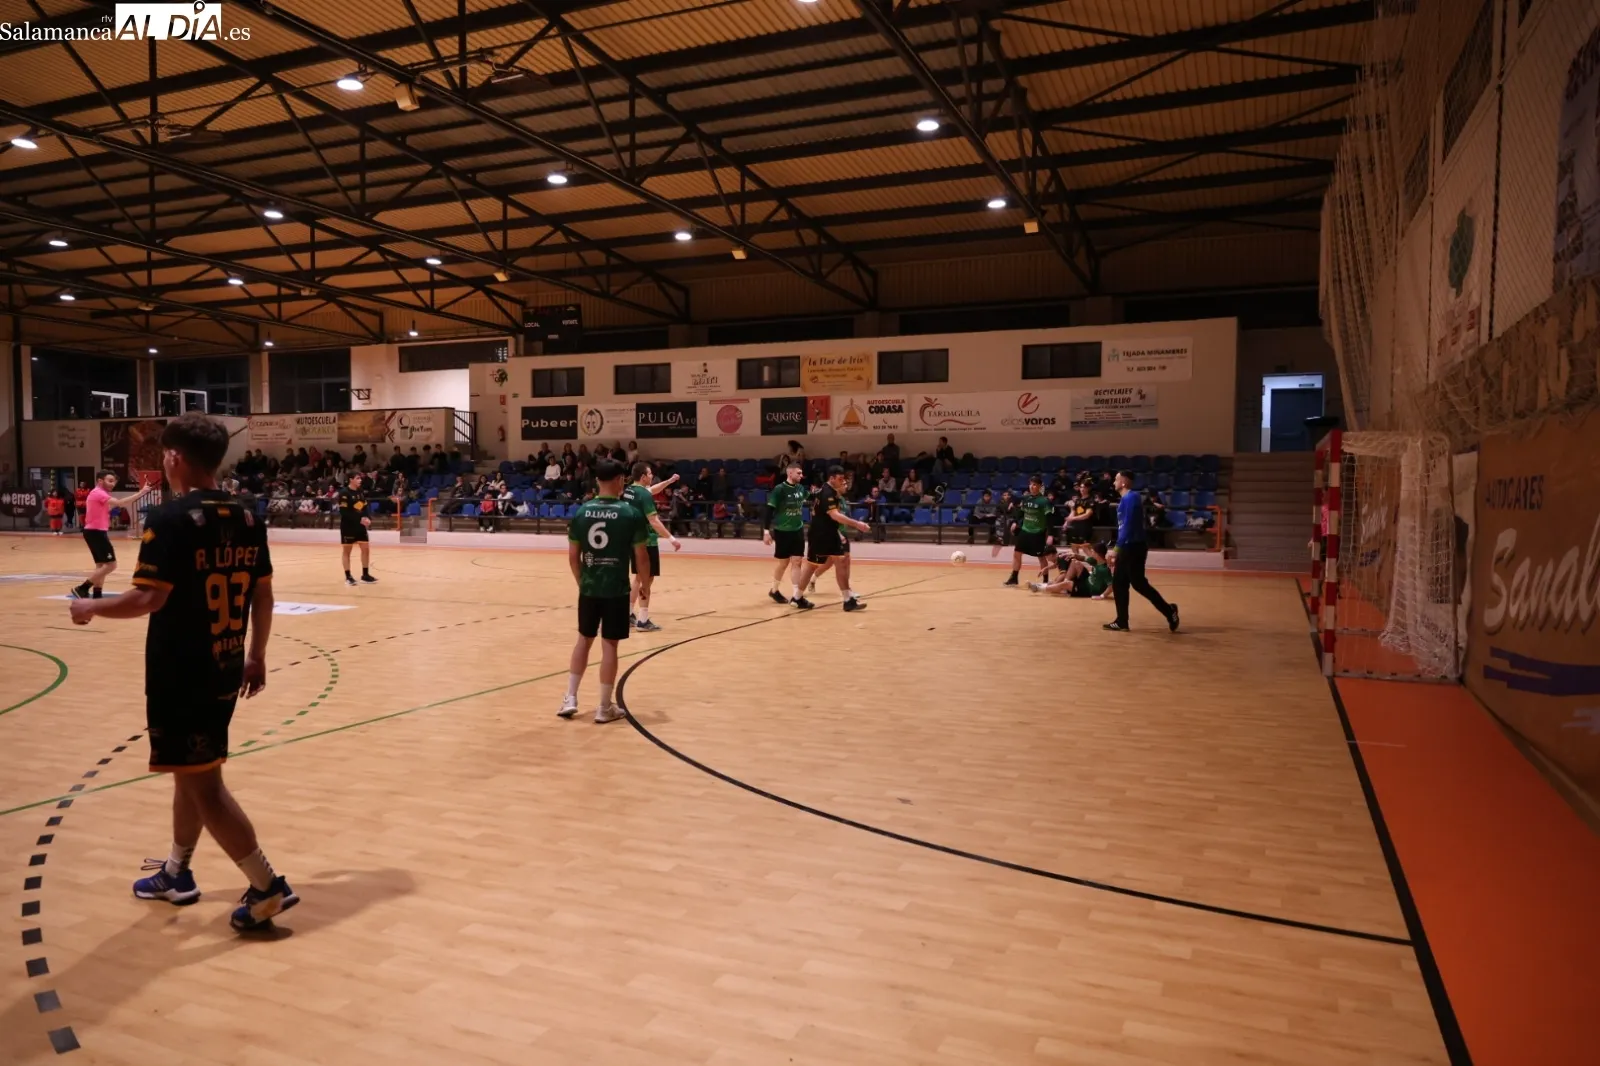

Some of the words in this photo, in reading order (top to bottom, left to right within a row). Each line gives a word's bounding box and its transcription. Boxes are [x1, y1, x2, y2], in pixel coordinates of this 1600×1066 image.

[868, 405, 904, 414] CODASA
[296, 416, 336, 425] AUTOESCUELA
[522, 419, 578, 428] Pubeer
[11, 492, 37, 507] errea
[1484, 474, 1545, 510] AUTOCARES
[585, 509, 618, 520] D.LIAÑO
[587, 521, 609, 549] 6
[195, 546, 210, 571] A.
[215, 542, 260, 568] LÓPEZ
[205, 570, 250, 636] 93
